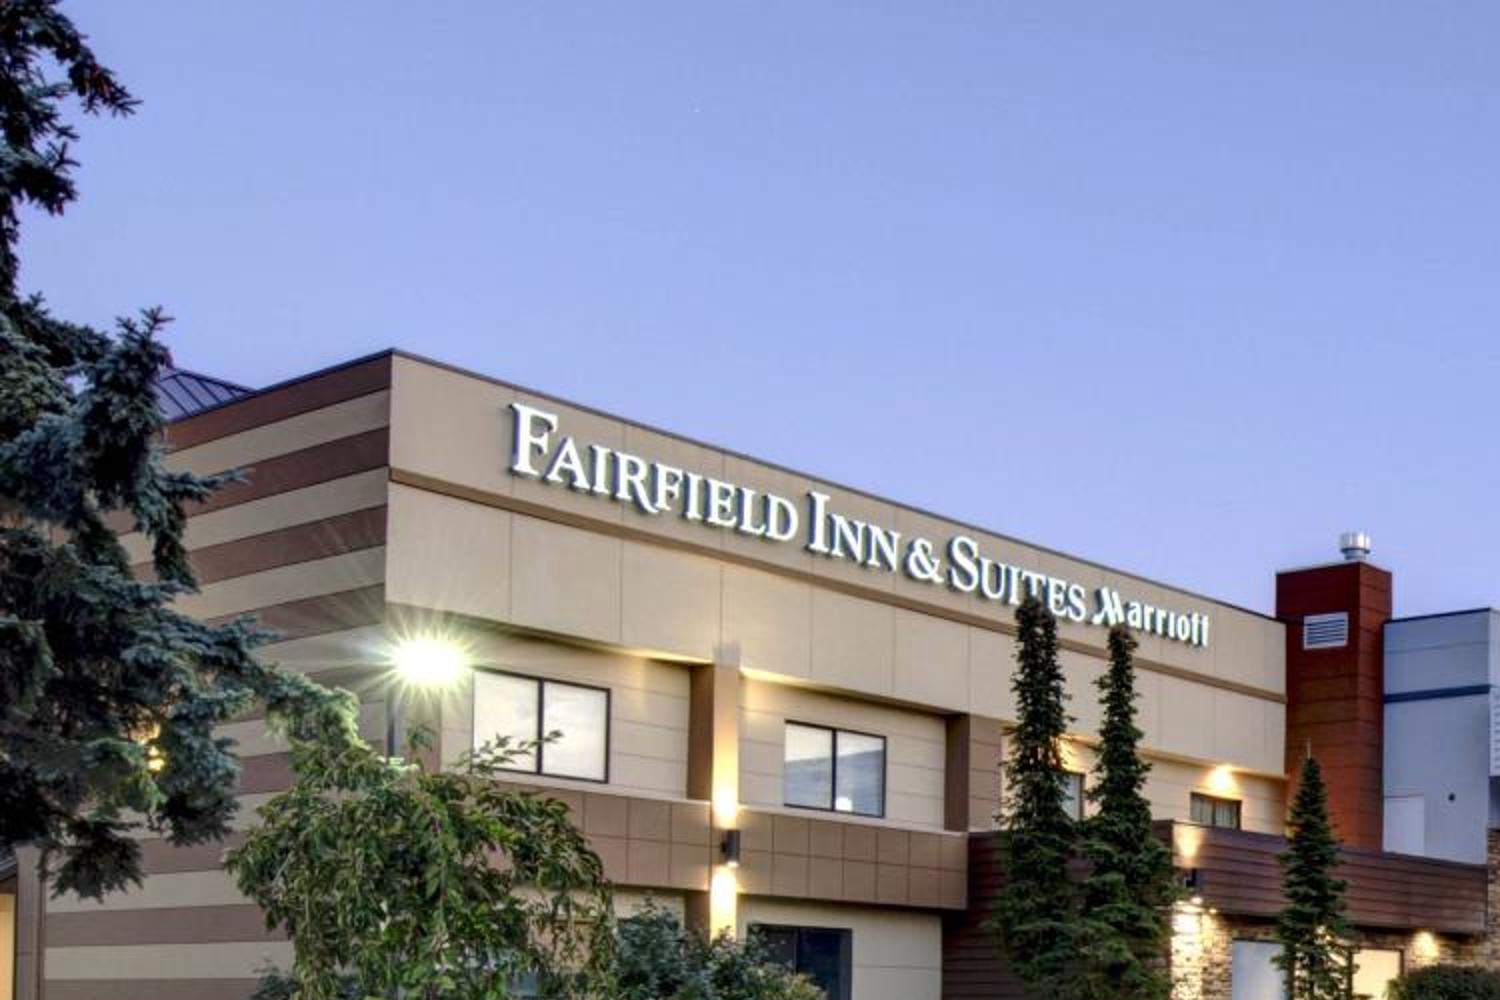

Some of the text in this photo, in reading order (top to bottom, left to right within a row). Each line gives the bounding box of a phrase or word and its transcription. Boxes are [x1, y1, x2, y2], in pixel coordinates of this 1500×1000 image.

[509, 402, 1210, 648] FAIRFIELD INN & SUITES Marriott
